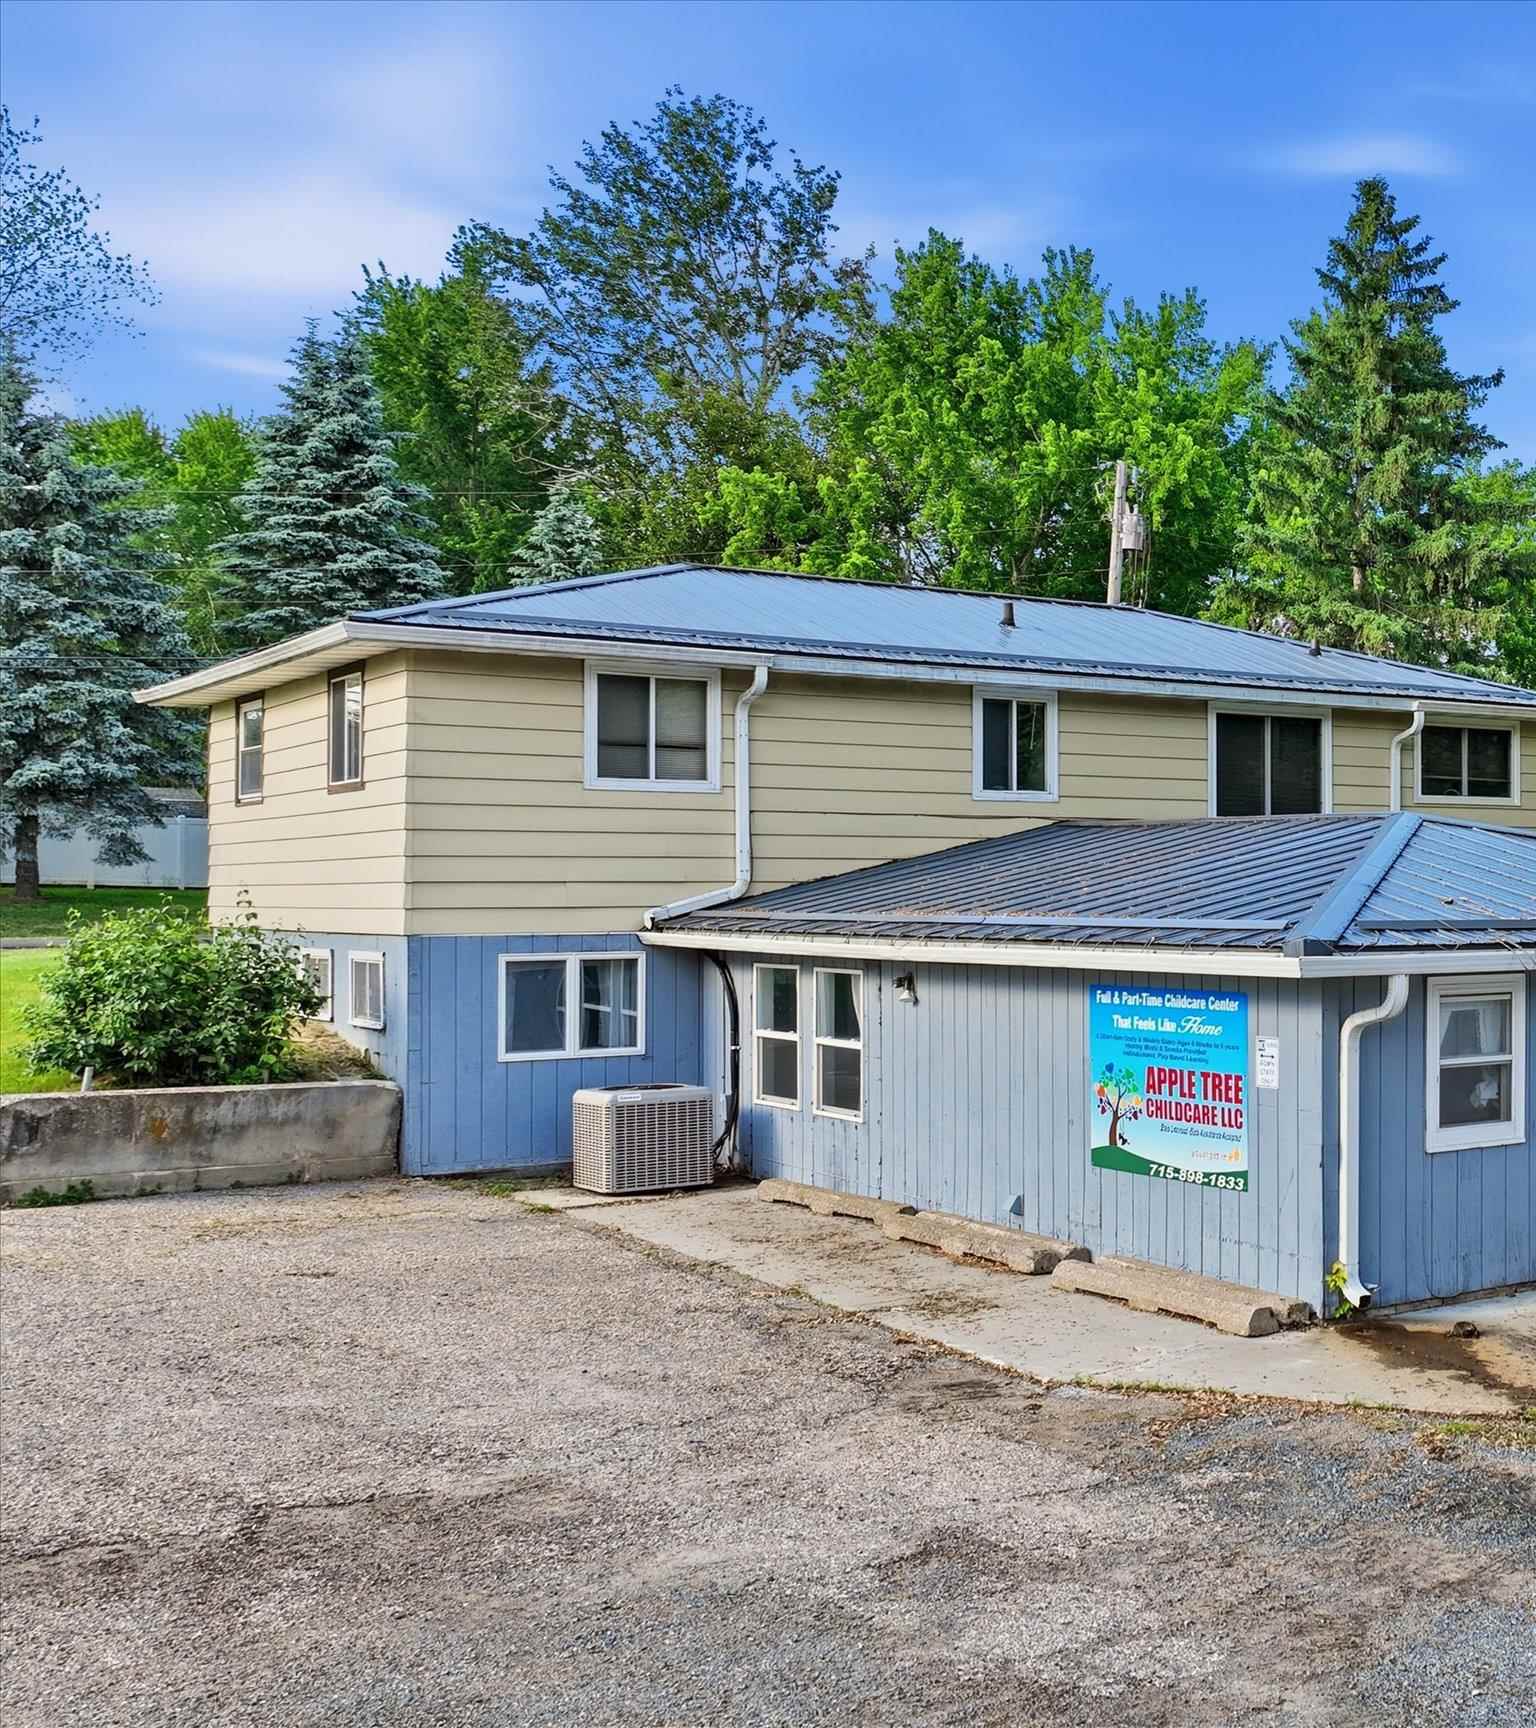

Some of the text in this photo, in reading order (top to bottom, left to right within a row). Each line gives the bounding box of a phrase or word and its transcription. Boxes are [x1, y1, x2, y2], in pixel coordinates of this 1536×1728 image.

[1113, 991, 1120, 1004] &
[1122, 992, 1163, 1006] Part-Time
[1165, 994, 1206, 1009] Childcare
[1208, 996, 1239, 1012] Center
[1112, 1014, 1223, 1036] That Feels Like Home
[1146, 1066, 1196, 1099] APPLE
[1200, 1071, 1243, 1105] TREE
[1146, 1098, 1243, 1129] CHILDCARE LLC
[1149, 1164, 1244, 1191] 715-898-1833
